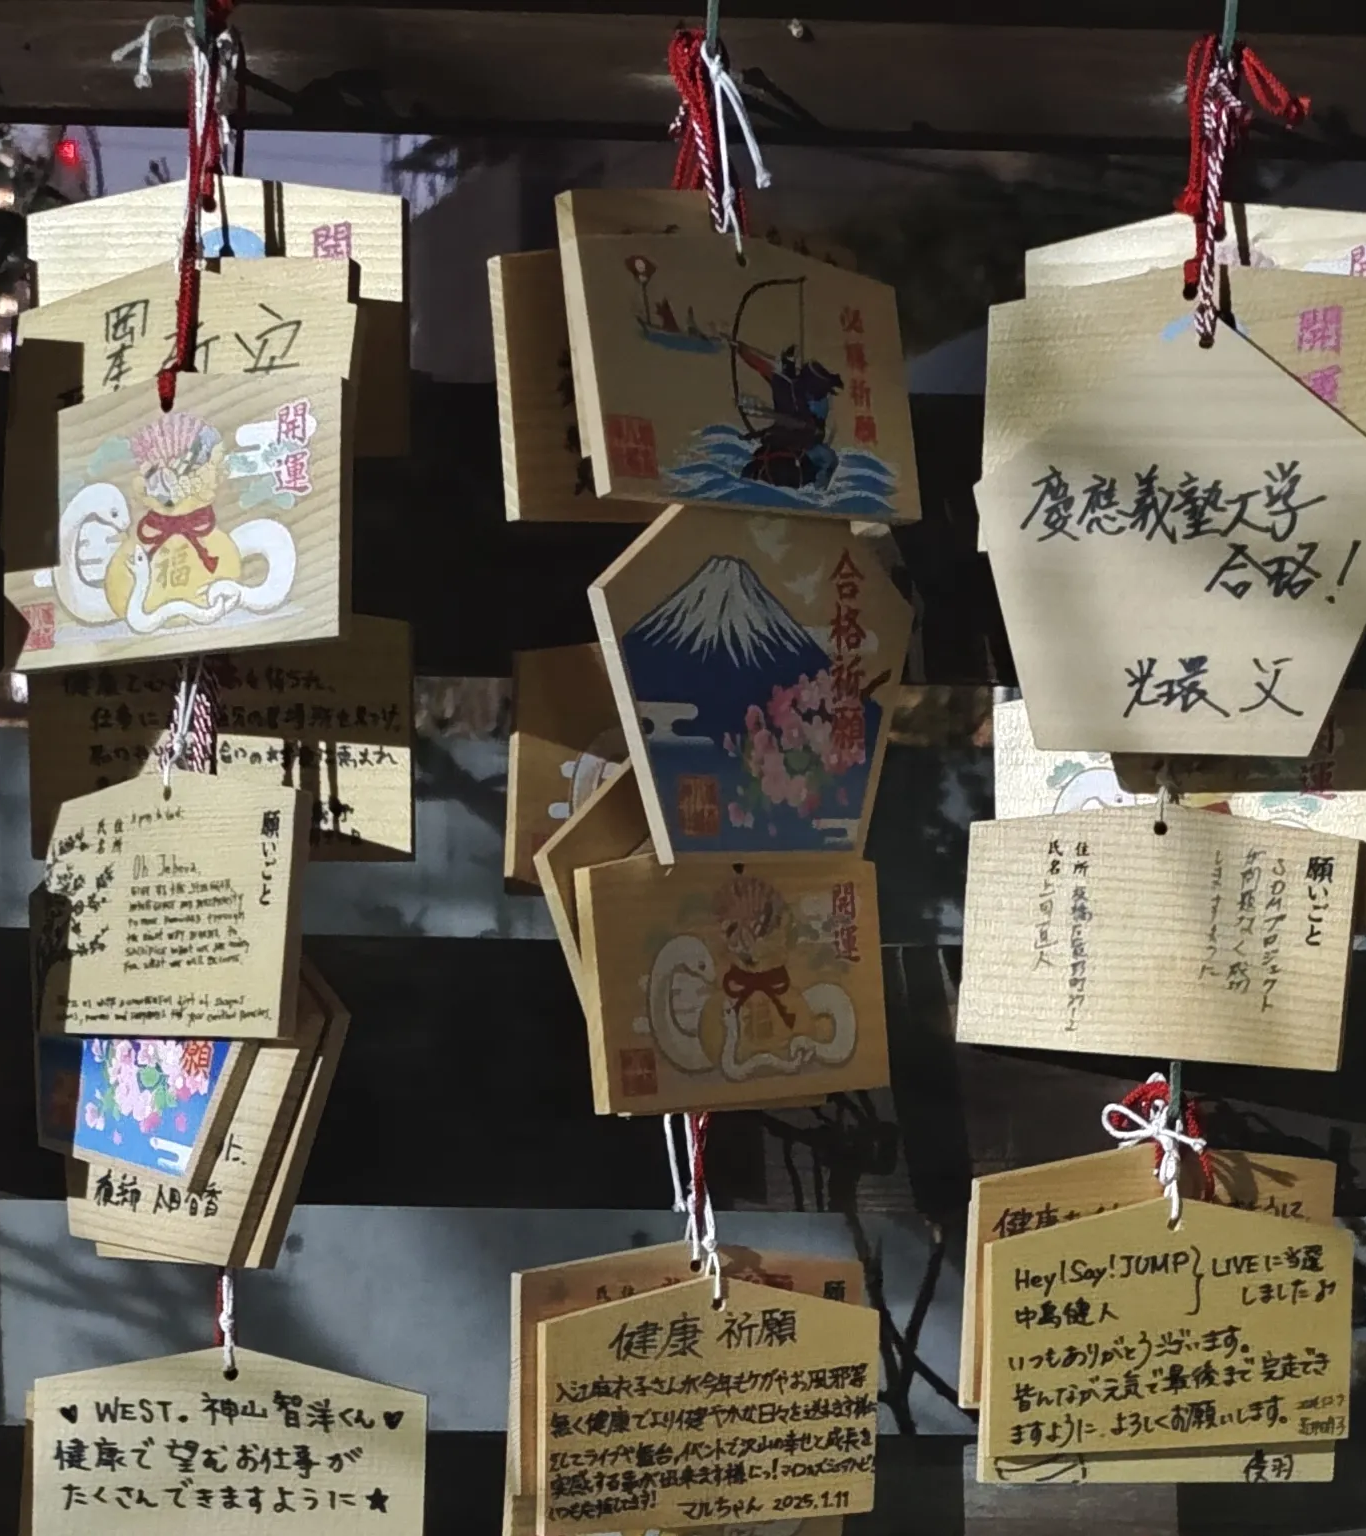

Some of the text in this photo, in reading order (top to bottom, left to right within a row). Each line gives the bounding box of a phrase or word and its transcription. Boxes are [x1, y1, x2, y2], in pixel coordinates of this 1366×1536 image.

[276, 400, 312, 495] 開運
[1020, 461, 1329, 543] 慶應義塾大学
[828, 547, 867, 749] 合格祈願
[259, 809, 281, 906] 願いごと
[1304, 855, 1335, 946] 願いごと
[1014, 1298, 1119, 1329] 中島健人
